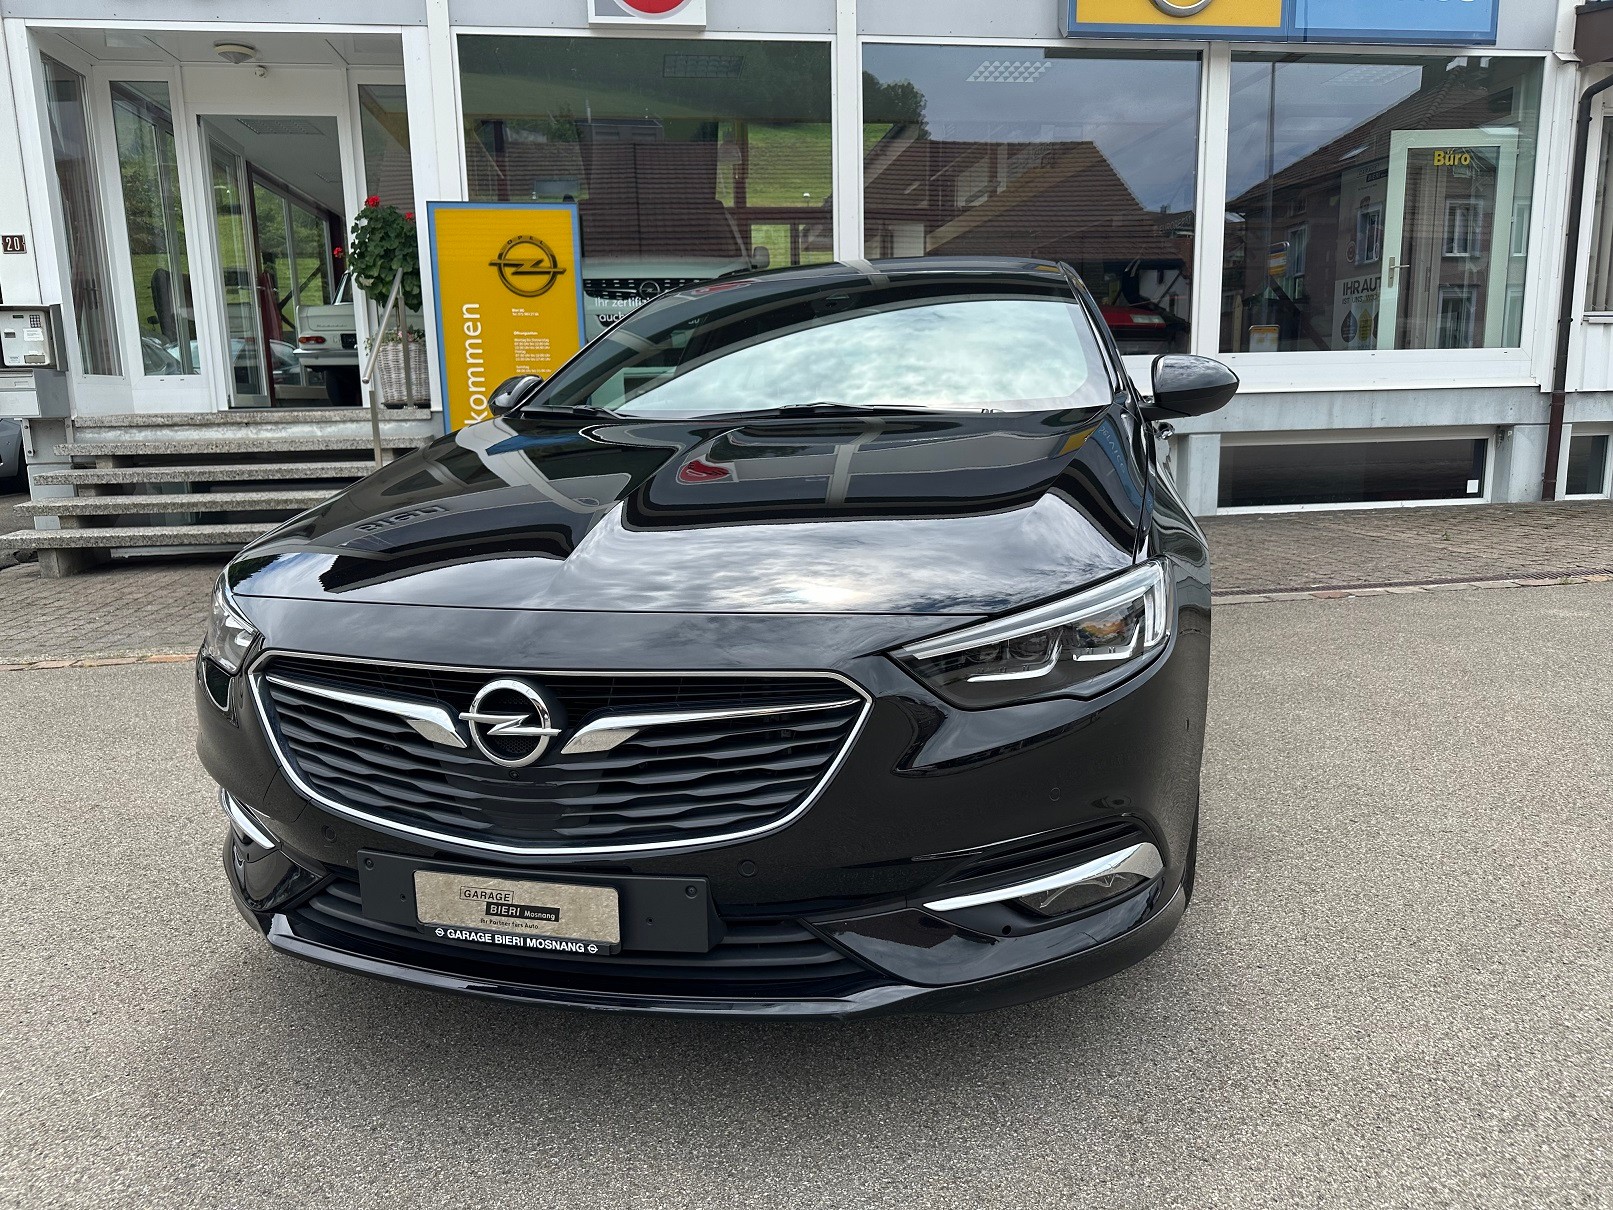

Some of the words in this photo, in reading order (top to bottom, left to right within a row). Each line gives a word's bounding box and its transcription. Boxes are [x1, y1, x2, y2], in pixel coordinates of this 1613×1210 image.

[1433, 149, 1471, 166] Büro
[5, 237, 21, 251] 20
[1343, 279, 1360, 297] IHR
[594, 297, 609, 307] Ihr
[463, 889, 511, 902] GARAGE
[490, 904, 520, 916] BIERI
[524, 910, 556, 921] Mosnang
[489, 919, 511, 927] Partner
[446, 929, 492, 943] GARAGE
[494, 934, 524, 947] BIERI
[526, 938, 585, 953] MOSNANG
